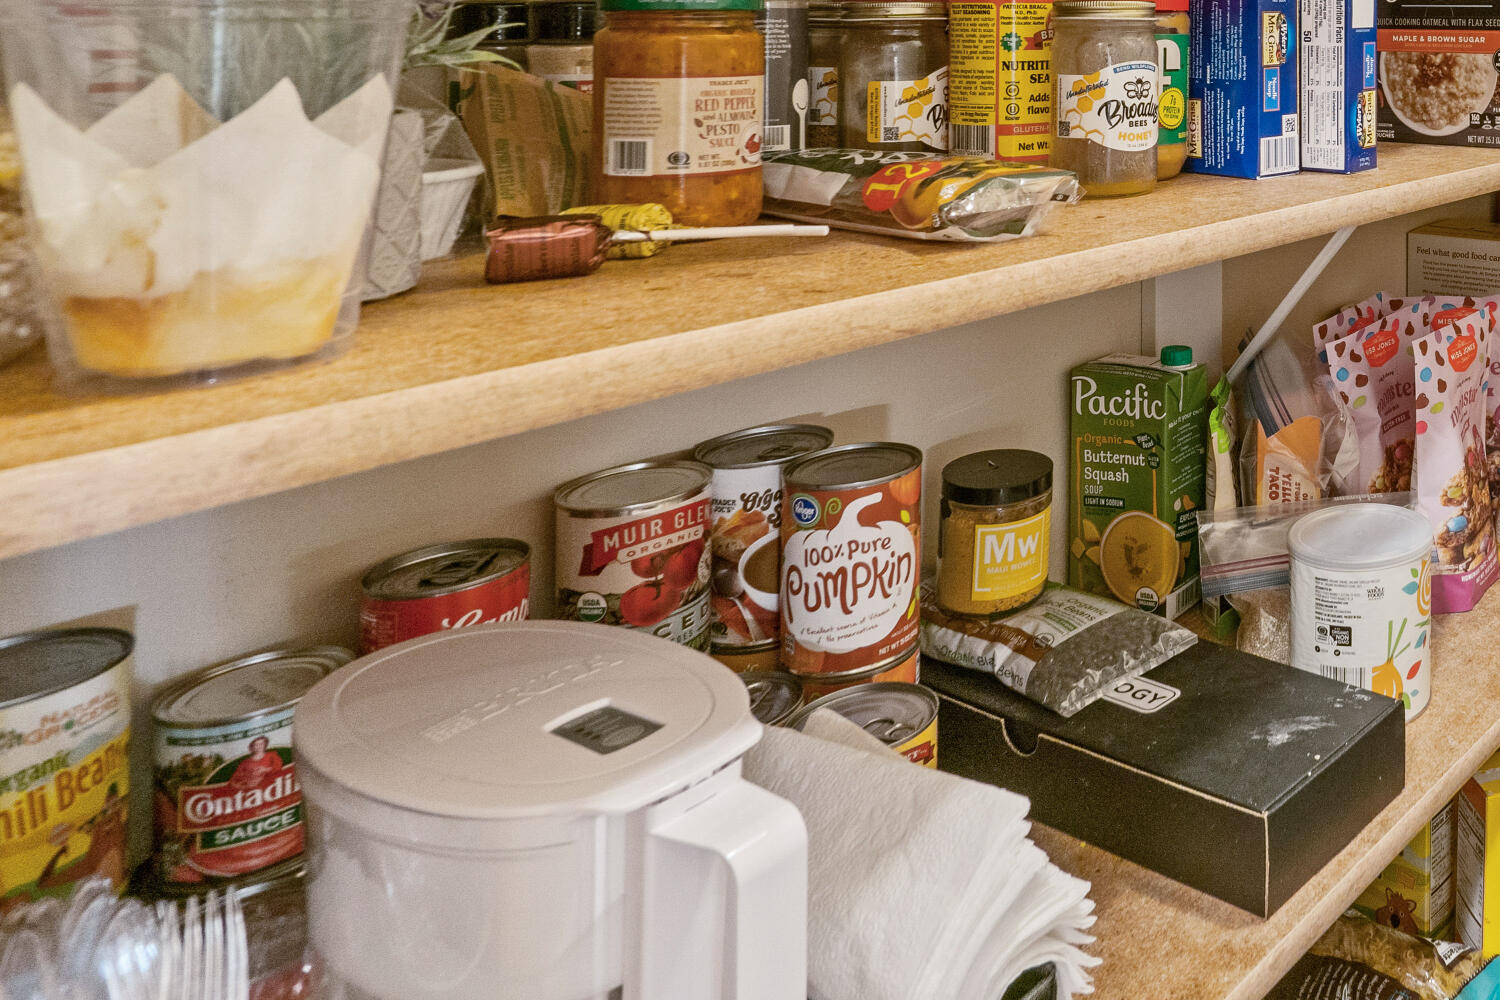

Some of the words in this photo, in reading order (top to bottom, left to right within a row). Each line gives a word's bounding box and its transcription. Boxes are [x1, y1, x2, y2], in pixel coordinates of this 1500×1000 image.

[1267, 14, 1276, 34] Mrs
[1394, 18, 1421, 26] COOKING
[1468, 19, 1484, 27] FLAX
[1303, 30, 1312, 43] 50
[1267, 35, 1276, 64] Grass
[695, 99, 720, 112] RED
[1163, 106, 1181, 114] PROTEIN
[706, 123, 740, 137] PESTO
[1129, 120, 1148, 128] BEES
[709, 138, 735, 148] SAUCE
[1118, 131, 1152, 142] HONEY
[1467, 135, 1477, 143] NET
[1477, 136, 1485, 144] WT
[1018, 142, 1035, 151] Net
[1416, 246, 1431, 255] Feel
[1432, 247, 1450, 257] what
[1451, 250, 1470, 260] good
[1471, 253, 1487, 261] food
[1377, 337, 1395, 350] JONES
[1462, 341, 1476, 356] JONES
[1071, 375, 1167, 420] Pacific
[1103, 418, 1135, 428] FOODS
[1083, 432, 1123, 446] Organic
[1083, 449, 1146, 467] Butternut
[1083, 467, 1130, 484] Squash
[1084, 484, 1104, 494] SOUP
[1268, 466, 1280, 501] TACO
[1085, 497, 1100, 506] LIGHT
[1105, 498, 1125, 507] SODIUM
[603, 518, 664, 553] MUIR
[626, 528, 701, 558] ORGANIC
[983, 531, 1040, 565] Mw
[804, 543, 845, 568] 100%
[1139, 591, 1154, 600] USDA
[215, 809, 297, 845] SAUCE
